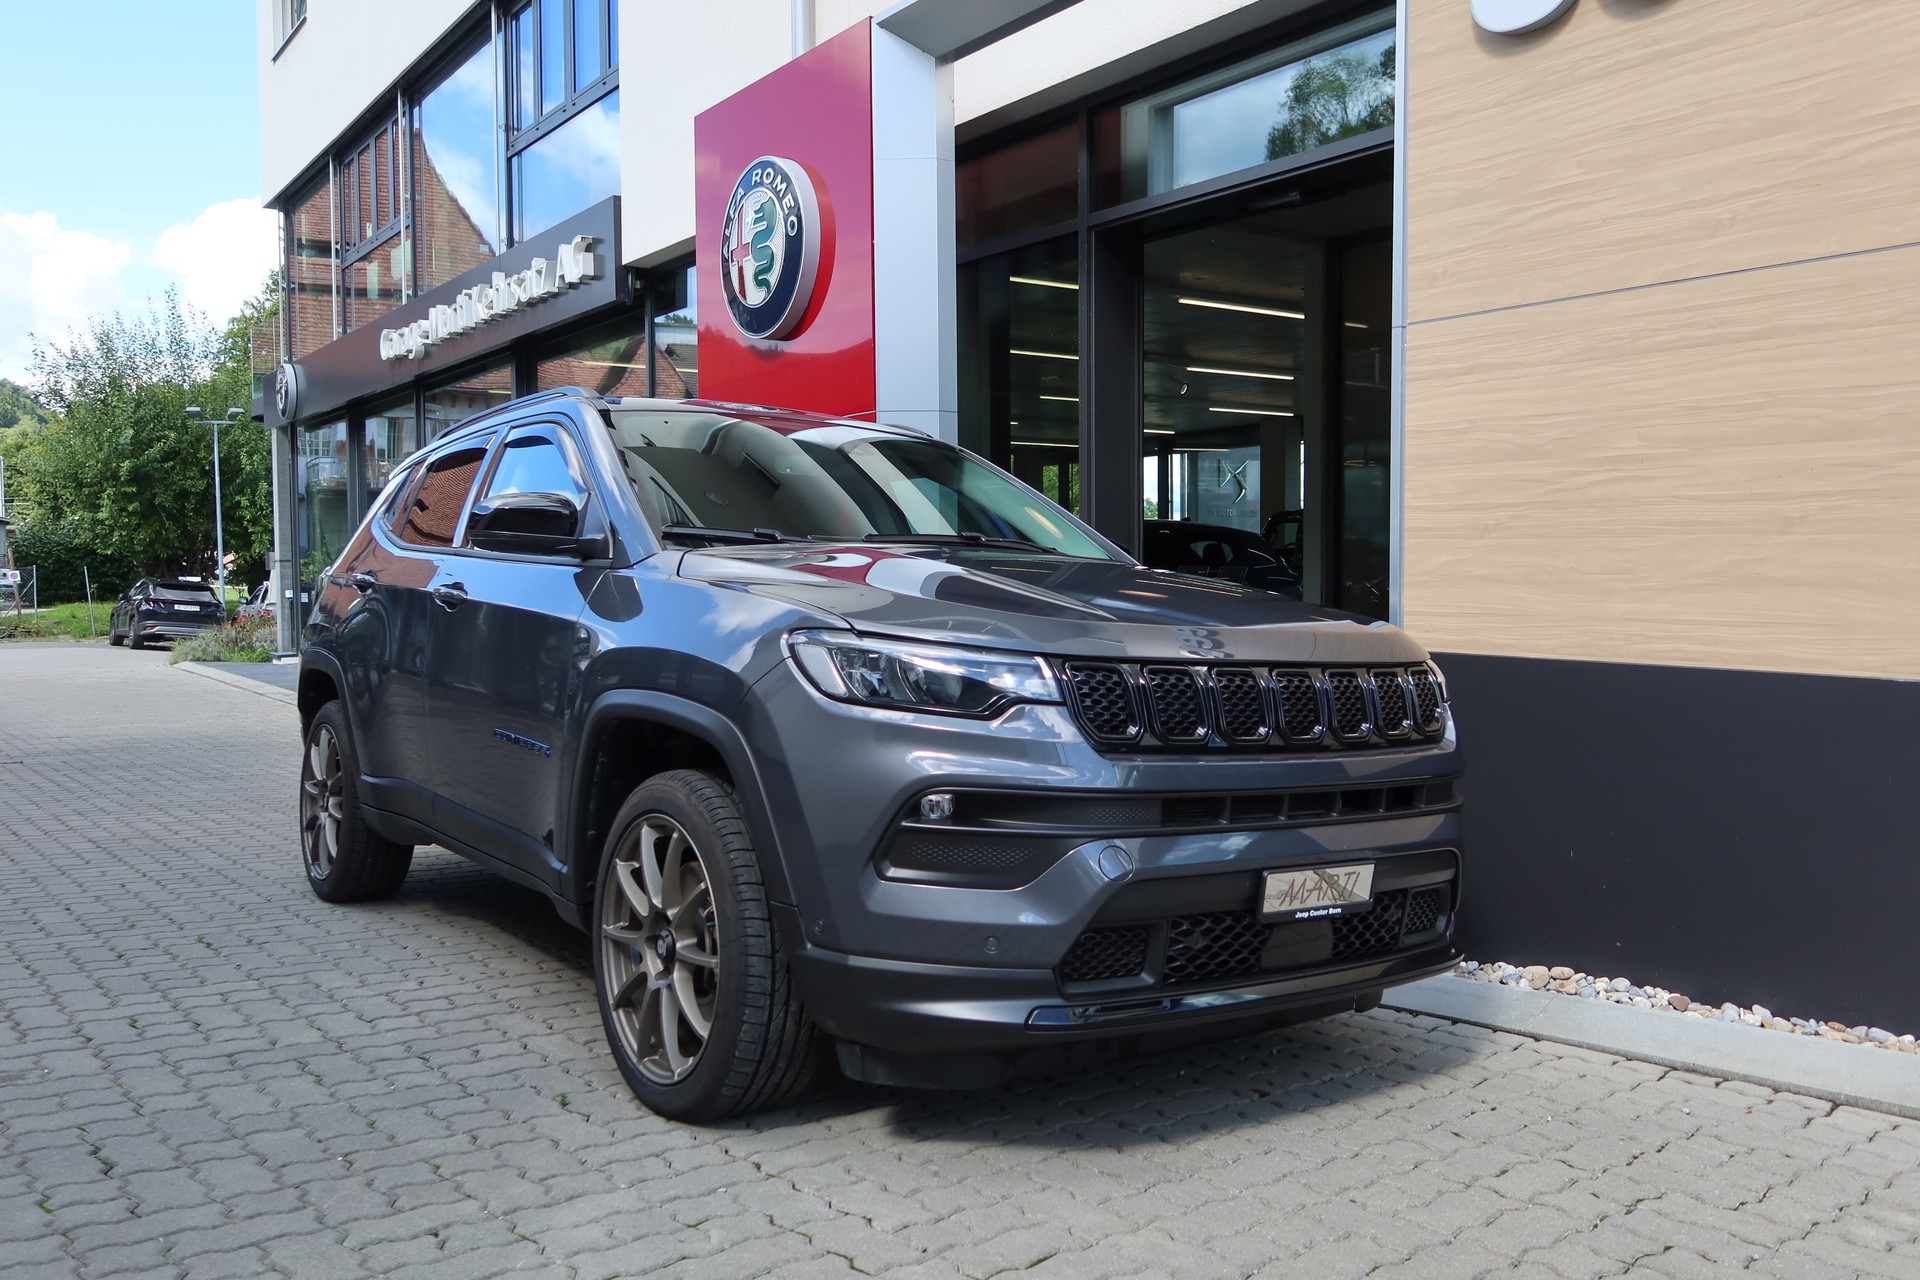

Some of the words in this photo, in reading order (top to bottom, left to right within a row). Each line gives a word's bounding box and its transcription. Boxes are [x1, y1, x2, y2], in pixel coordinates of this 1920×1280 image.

[723, 189, 745, 261] ALFA
[752, 167, 798, 237] ROMEO
[555, 235, 595, 288] AG
[1295, 911, 1309, 919] Jeep
[1328, 907, 1342, 915] Bern
